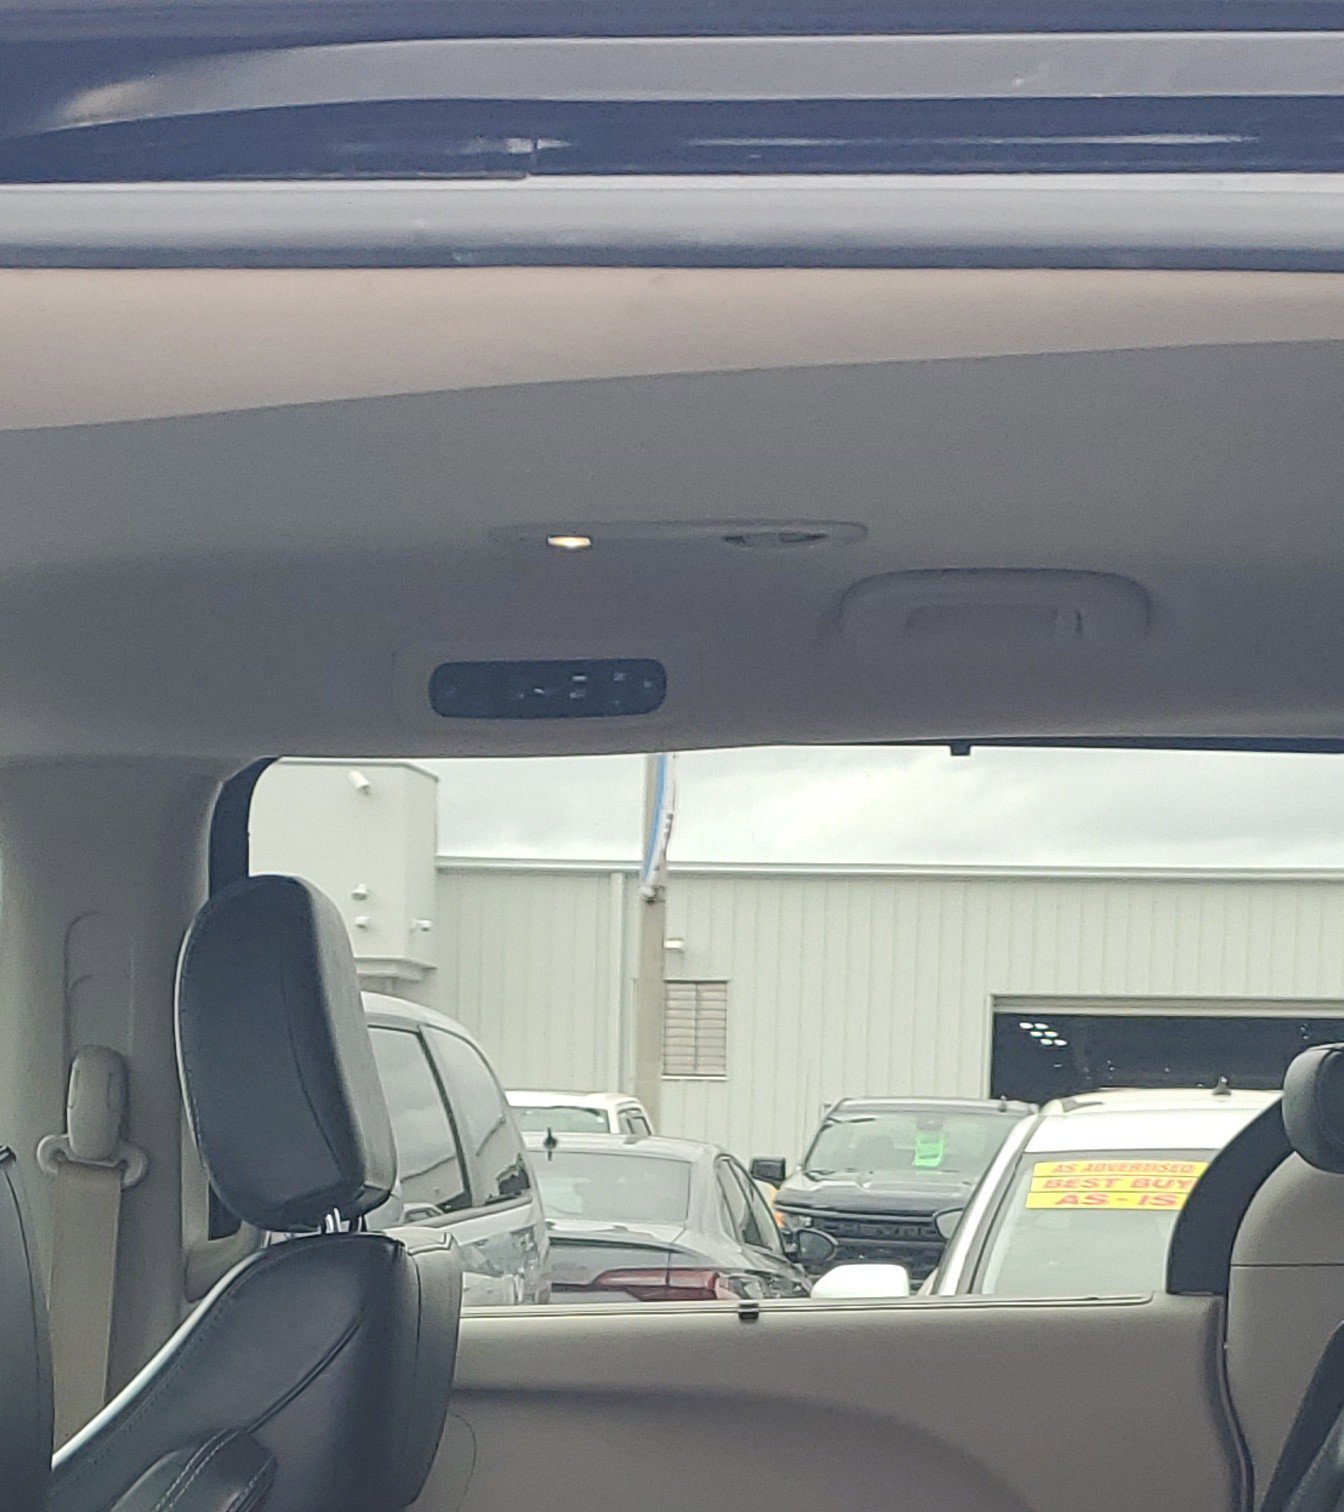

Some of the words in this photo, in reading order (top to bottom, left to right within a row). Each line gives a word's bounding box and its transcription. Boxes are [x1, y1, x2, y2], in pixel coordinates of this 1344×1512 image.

[1052, 1163, 1077, 1174] AS
[1081, 1163, 1196, 1175] ADVERTISED
[1043, 1178, 1124, 1189] BEST
[1130, 1178, 1194, 1190] BUY
